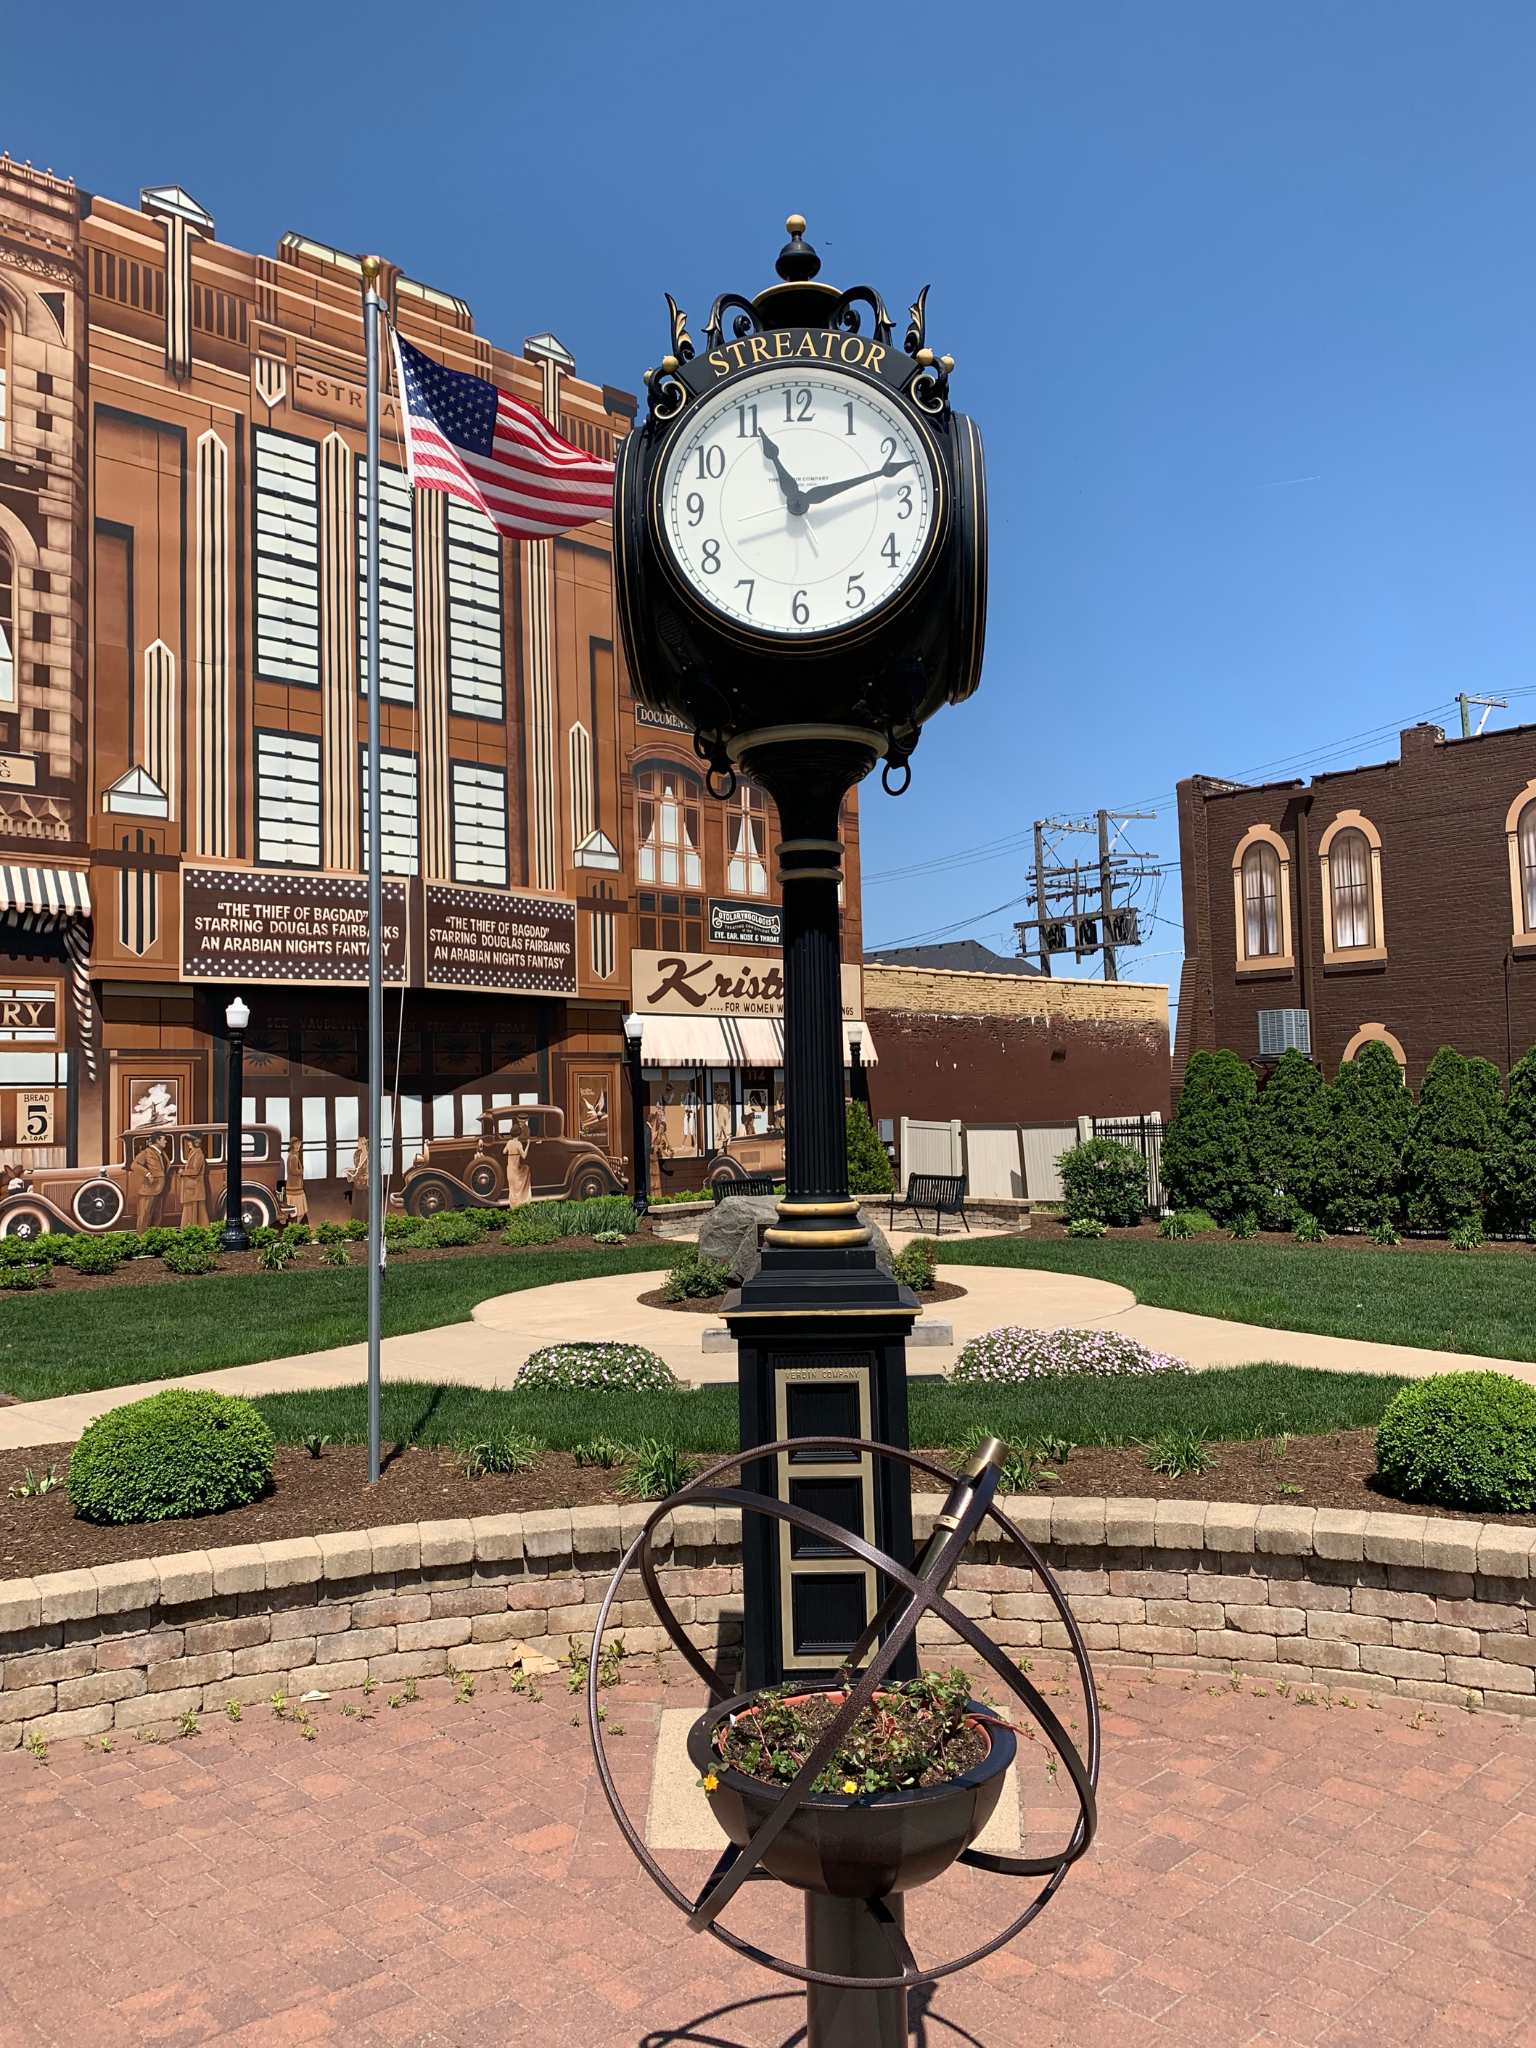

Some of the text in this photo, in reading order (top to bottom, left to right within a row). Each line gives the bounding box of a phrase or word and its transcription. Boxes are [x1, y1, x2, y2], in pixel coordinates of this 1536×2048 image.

[708, 331, 886, 377] STREATOR
[316, 380, 402, 419] STRA
[782, 388, 816, 422] 12
[736, 403, 760, 438] 11
[843, 401, 857, 435] 1
[695, 445, 726, 479] 10
[880, 436, 898, 467] 2
[686, 492, 704, 526] 9
[897, 485, 913, 519] 3
[701, 539, 721, 575] 8
[880, 533, 901, 568] 4
[734, 579, 755, 615] 7
[845, 572, 866, 608] 5
[792, 590, 810, 625] 6
[640, 708, 689, 730] DOCUMEN
[194, 917, 400, 939] STARRING DOUGLAS FAIRBKS
[253, 904, 291, 920] THIEF
[294, 906, 311, 920] OF
[470, 918, 496, 933] THIEF
[498, 921, 510, 935] OF
[200, 936, 391, 956] AN ARABIAN NIGHTS FANTY
[429, 928, 570, 954] STARRING DOUGLAS FAIRBANKS
[740, 933, 753, 942] NOSE
[760, 935, 779, 943] THROAT
[434, 945, 565, 970] AN ARABIAN NIGHTS FANTASY
[647, 958, 783, 1007] Krist
[743, 1002, 774, 1013] WOMEN
[266, 1017, 289, 1028] SEE
[298, 1018, 367, 1030] VAUDEVILL
[494, 1022, 526, 1033] TODAY
[746, 1069, 765, 1080] 112
[24, 1094, 50, 1102] BREAD
[785, 1370, 859, 1379] VERDIN COMPANY
